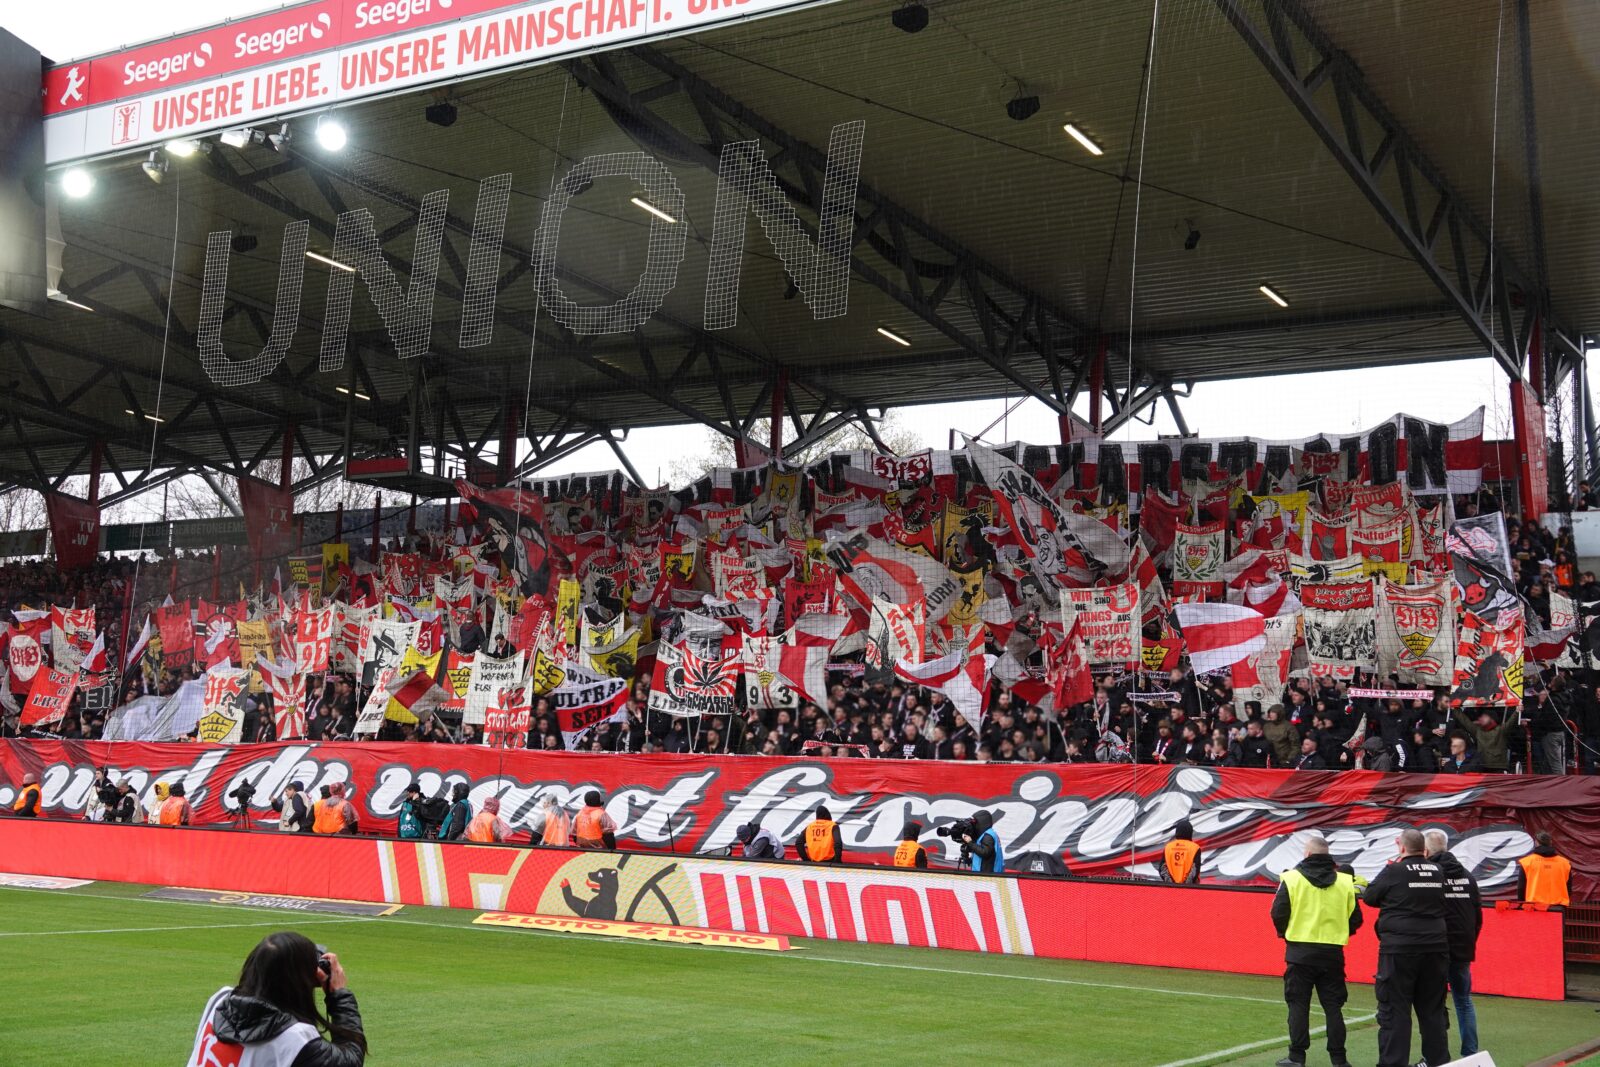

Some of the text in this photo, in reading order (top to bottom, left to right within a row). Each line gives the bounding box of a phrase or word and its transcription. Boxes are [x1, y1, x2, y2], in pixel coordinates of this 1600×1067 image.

[355, 0, 433, 28] Seeger
[234, 23, 309, 58] Seeger
[123, 52, 192, 86] Seeger
[152, 0, 674, 133] UNSERE LIEBE. UNSERE MANNSCHAFT.
[197, 119, 866, 387] UNION
[1071, 590, 1111, 606] WIR SIND
[1075, 603, 1087, 612] DIE
[1078, 610, 1131, 624] JUNGS AUS
[1082, 622, 1130, 638] ANNSTATT
[571, 702, 615, 729] SEIT
[812, 828, 826, 838] 101
[519, 917, 609, 930] LOTTO
[666, 929, 768, 945] LOTTO
